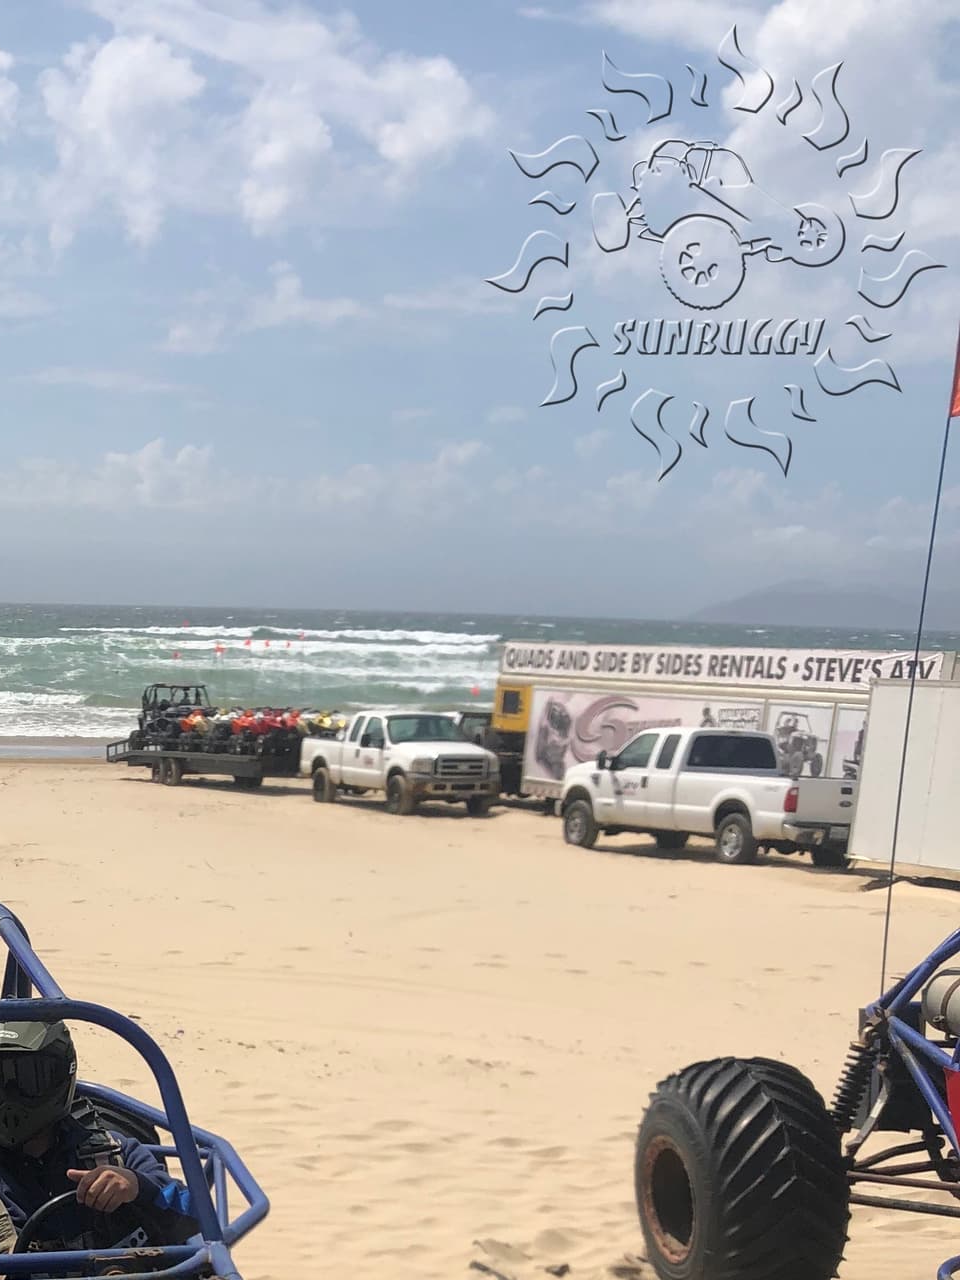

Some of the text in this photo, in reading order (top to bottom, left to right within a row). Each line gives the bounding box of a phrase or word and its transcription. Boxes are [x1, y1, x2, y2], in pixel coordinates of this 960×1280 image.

[505, 648, 936, 682] QUADS AND SIDE BY SIDES RENTALS STEVE'S ATV
